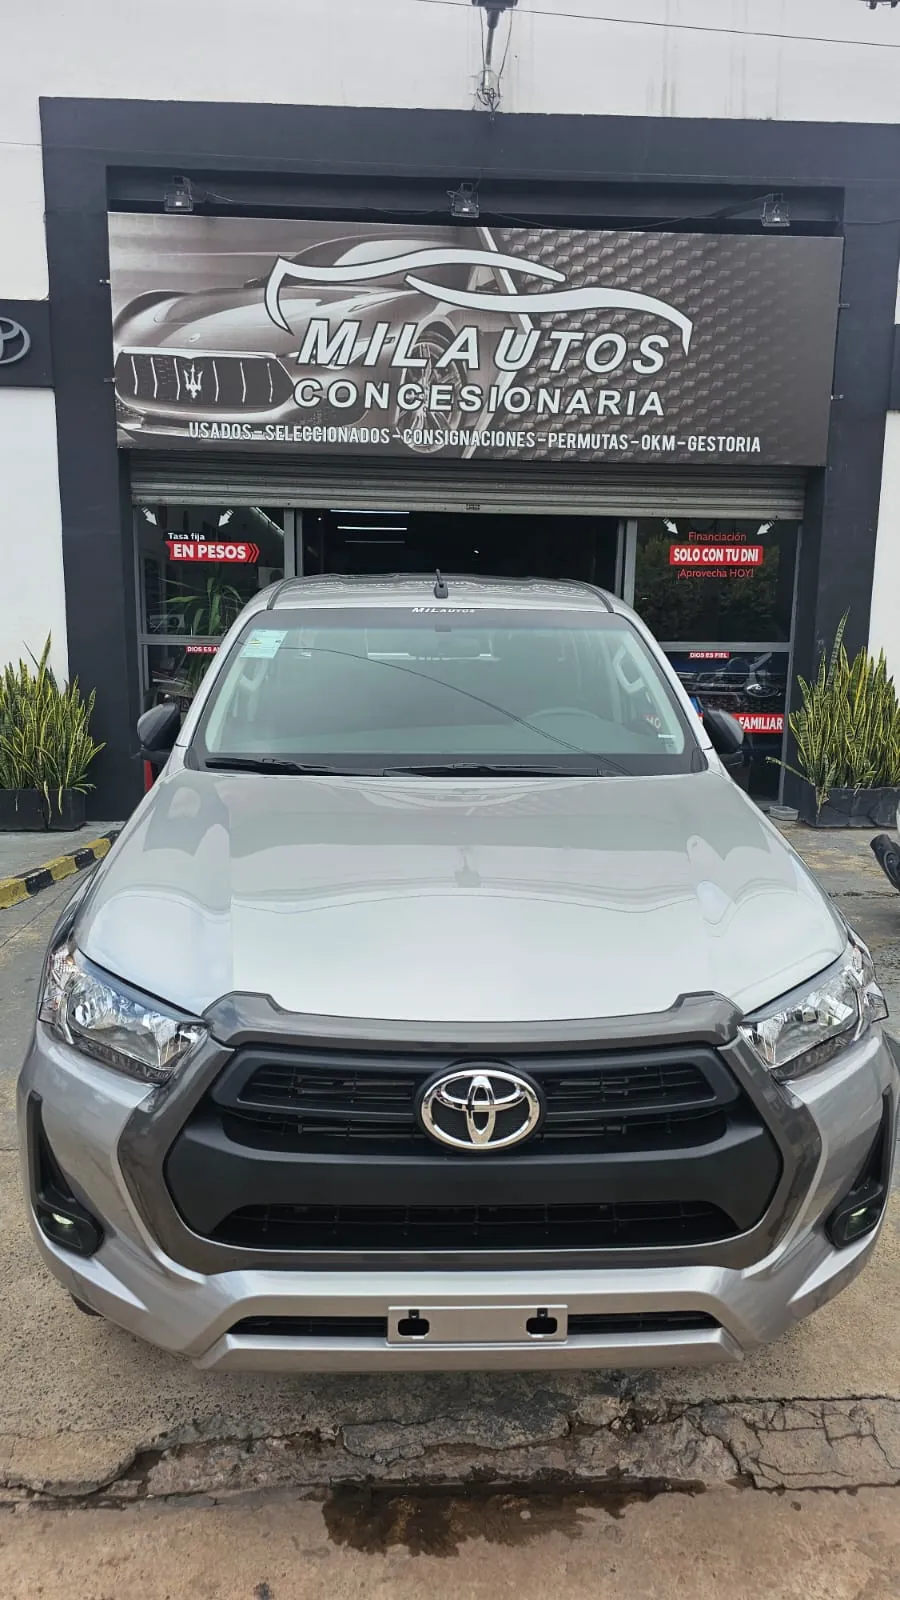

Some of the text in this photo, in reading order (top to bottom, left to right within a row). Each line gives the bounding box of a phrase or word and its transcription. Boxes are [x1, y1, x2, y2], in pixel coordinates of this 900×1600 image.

[297, 318, 671, 375] MILAUTOS
[293, 379, 664, 417] CONCESIONARIA
[168, 532, 206, 542] Tasa fija
[688, 531, 747, 542] Financiación
[173, 543, 247, 560] EN PESOS
[674, 548, 759, 562] SOLO CON TU DNI
[677, 568, 755, 580] ¡Aprovecha HOY!
